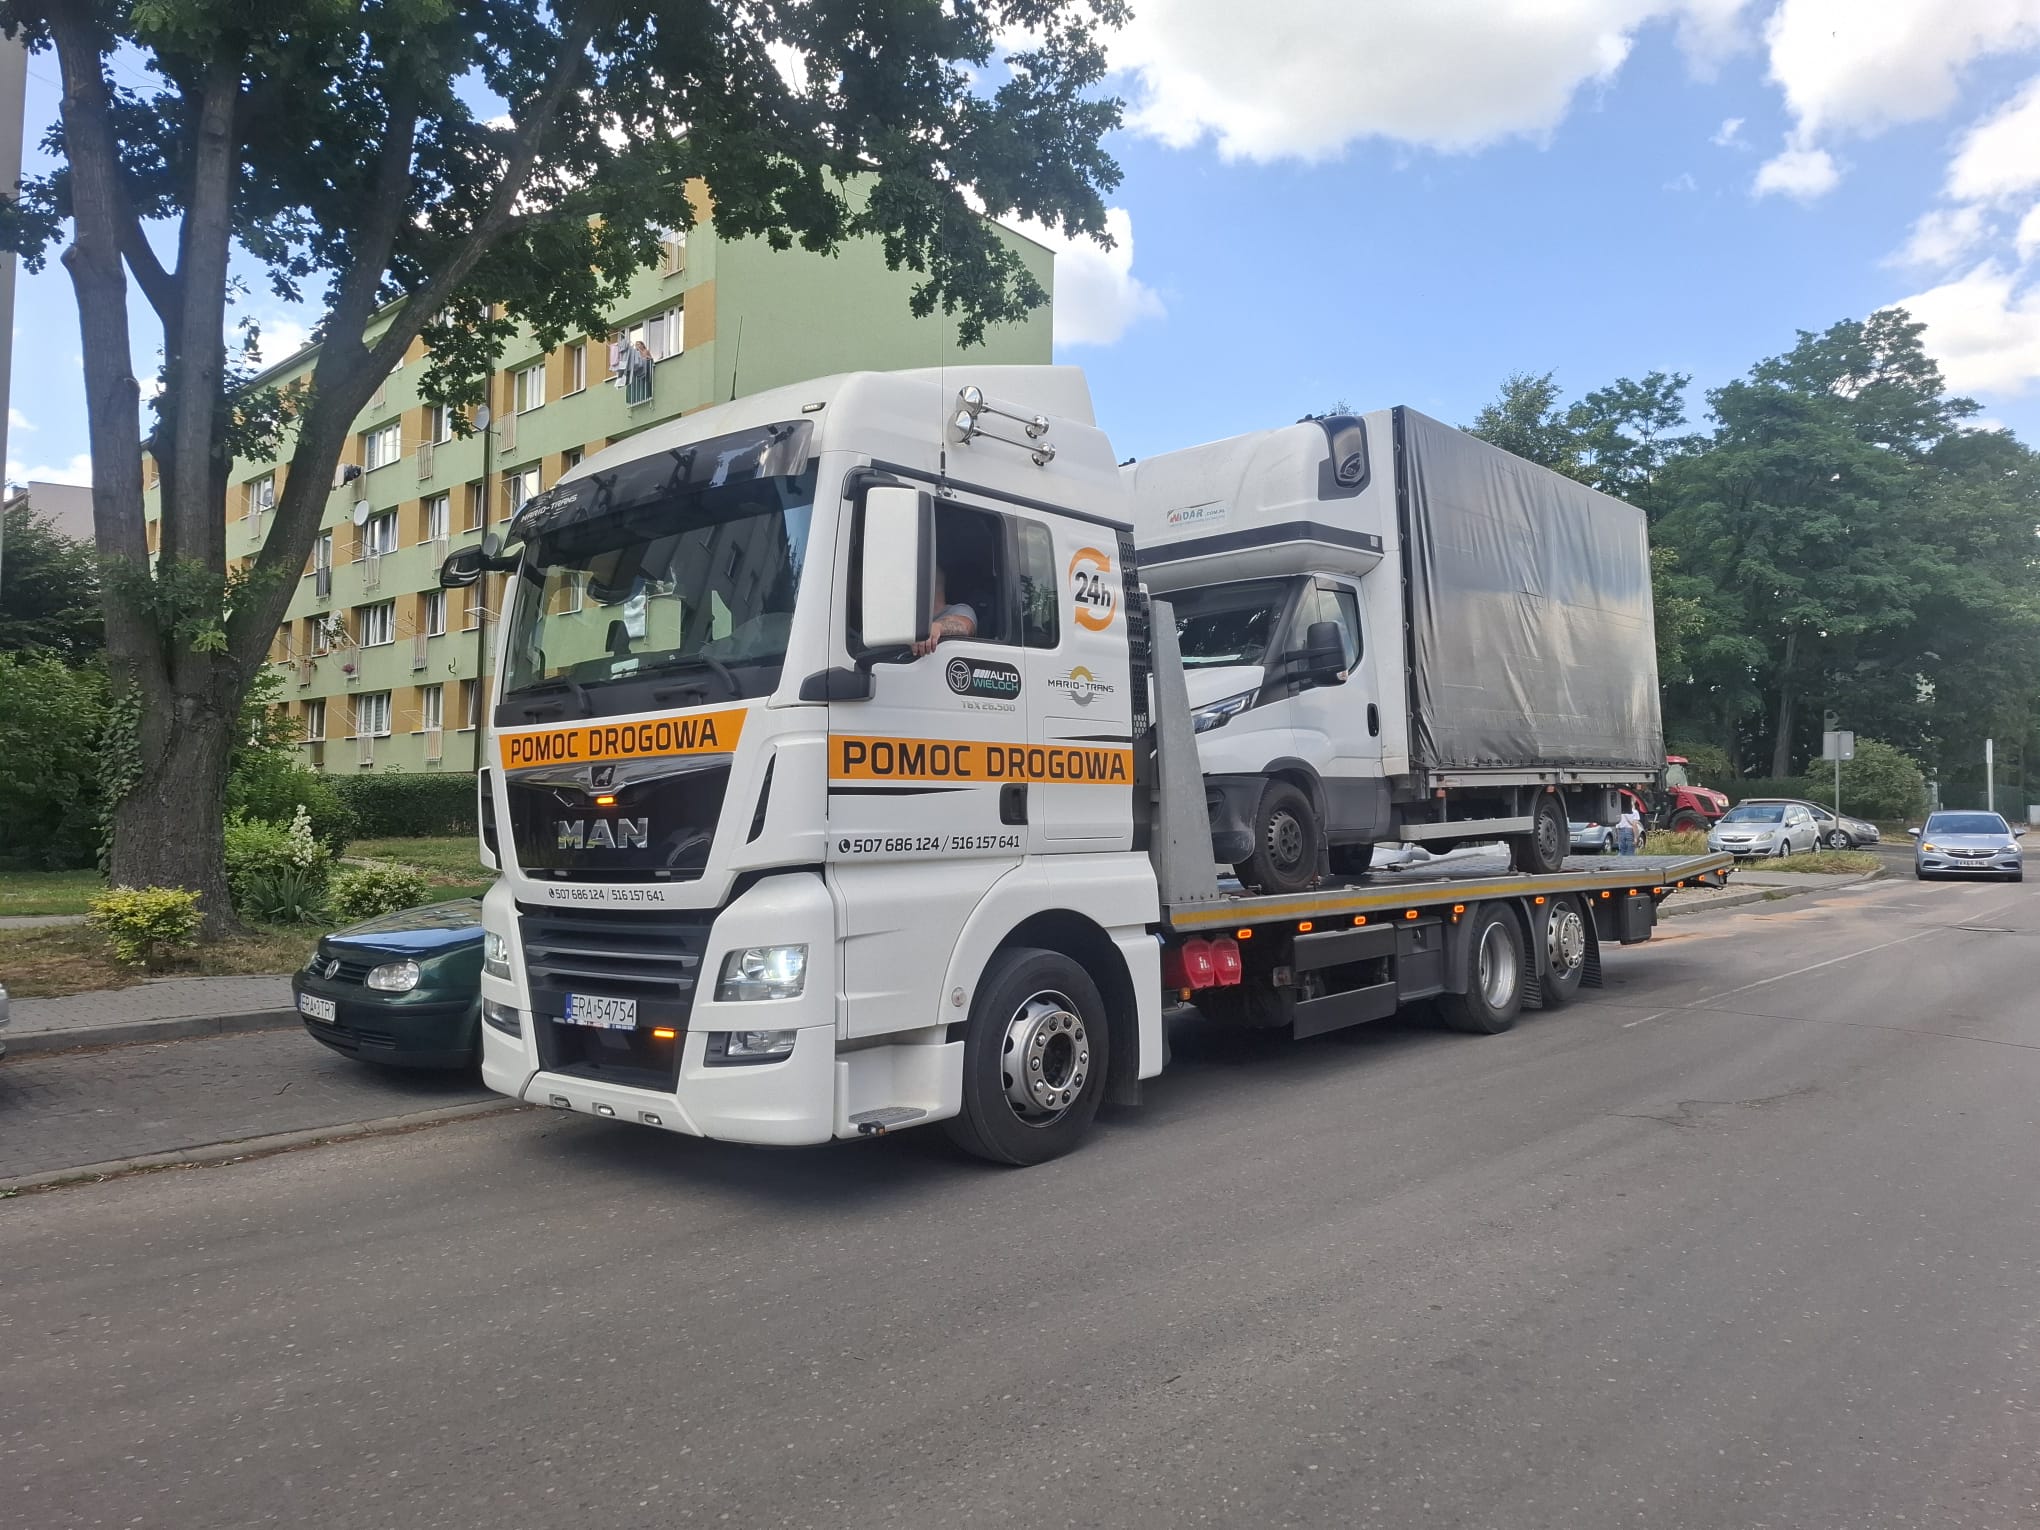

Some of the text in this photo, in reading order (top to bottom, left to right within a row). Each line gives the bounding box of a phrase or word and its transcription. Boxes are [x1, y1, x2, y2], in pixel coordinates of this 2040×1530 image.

[1075, 571, 1111, 607] 24h
[973, 678, 1019, 692] WIELOCH
[990, 671, 1019, 682] AUTO
[1047, 679, 1114, 693] MARIO-TRANS
[511, 718, 719, 764] POMOC DROGOWA
[843, 741, 1127, 781] POMOC DROGOWA
[557, 817, 649, 850] MAN
[853, 838, 882, 853] 507
[885, 837, 913, 852] 686
[916, 836, 940, 851] 124
[952, 836, 974, 850] 516
[976, 835, 996, 849] 157
[999, 835, 1020, 848] 641
[555, 888, 570, 900] 507
[572, 889, 588, 900] 686
[589, 889, 605, 900] 124
[611, 889, 628, 901] 516
[629, 890, 644, 901] 157
[646, 890, 665, 902] 641
[572, 996, 635, 1023] ERA 54754
